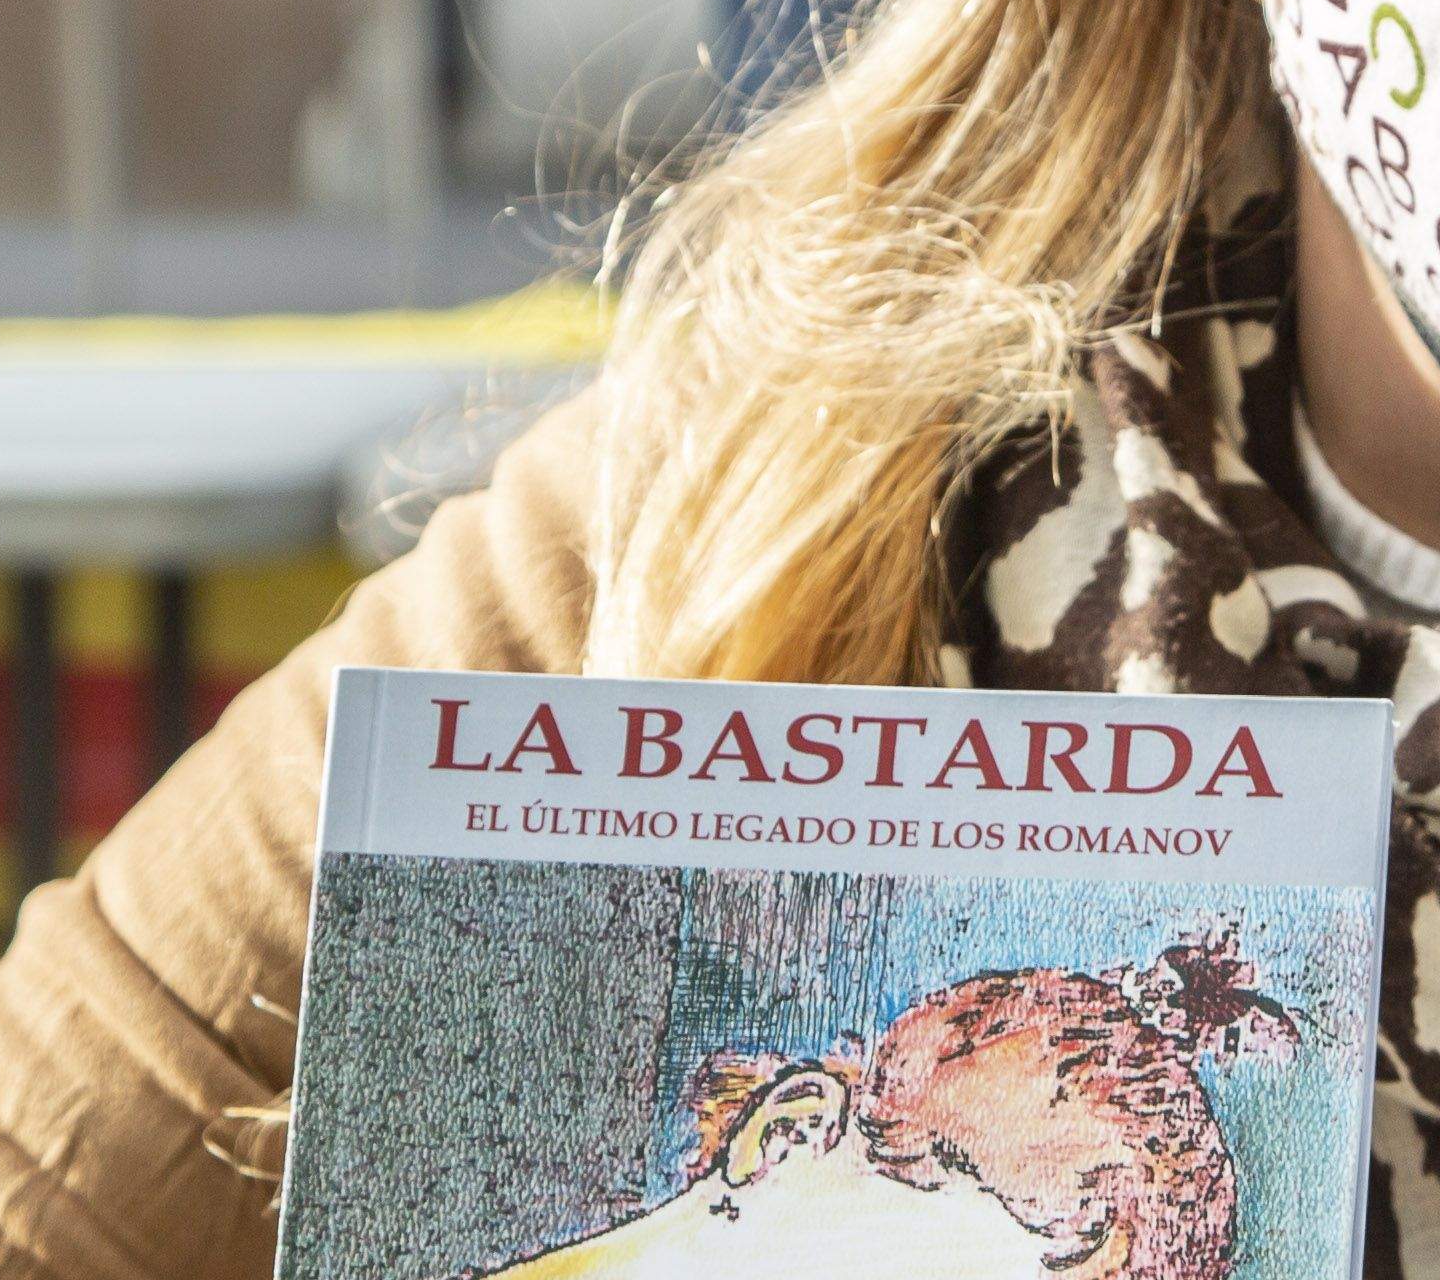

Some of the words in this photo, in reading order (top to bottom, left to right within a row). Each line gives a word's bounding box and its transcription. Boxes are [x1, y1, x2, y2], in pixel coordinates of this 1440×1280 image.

[1370, 2, 1427, 109] C
[427, 697, 583, 777] LA
[616, 706, 1284, 800] BASTARDA
[464, 803, 513, 834] EL
[520, 798, 678, 841] ÚLTIMO
[688, 812, 856, 848] LEGADO
[867, 819, 920, 849] DE
[931, 821, 1006, 852] LOS
[1017, 822, 1233, 858] ROMANOV
